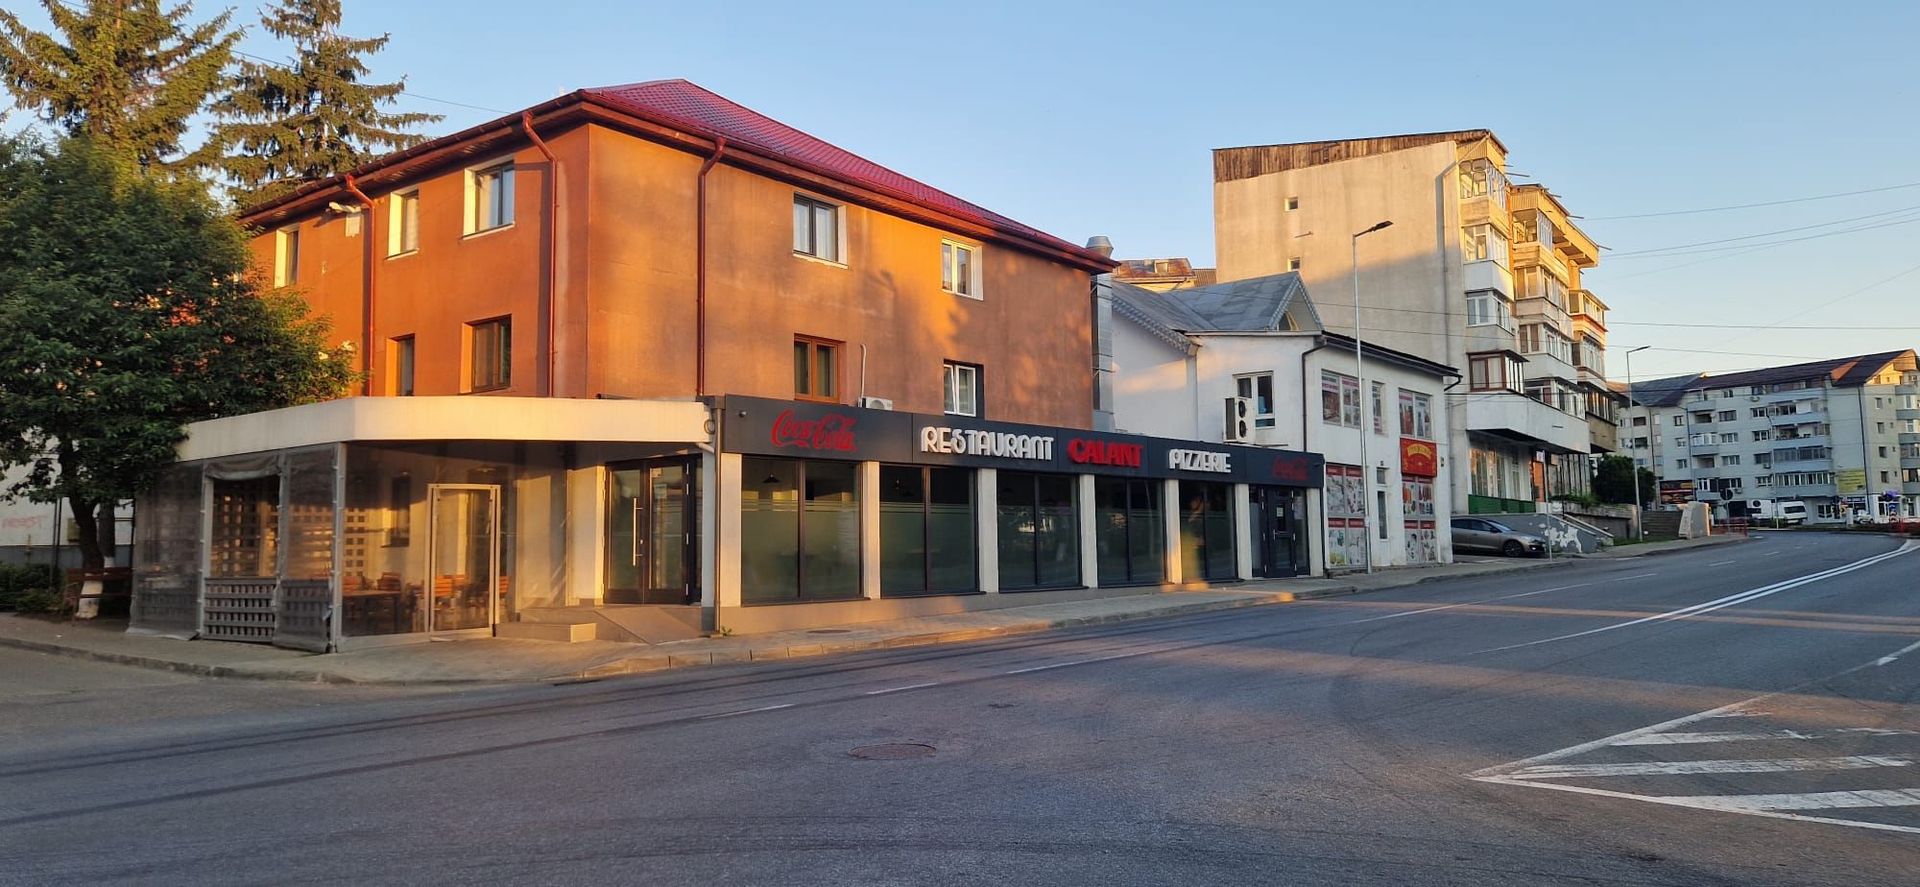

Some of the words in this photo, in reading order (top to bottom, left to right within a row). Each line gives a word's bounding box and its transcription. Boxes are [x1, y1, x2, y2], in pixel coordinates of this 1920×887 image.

[920, 426, 1054, 460] RESTAURANT
[1066, 438, 1144, 468] CALANT
[1168, 448, 1231, 473] PIZZERIE
